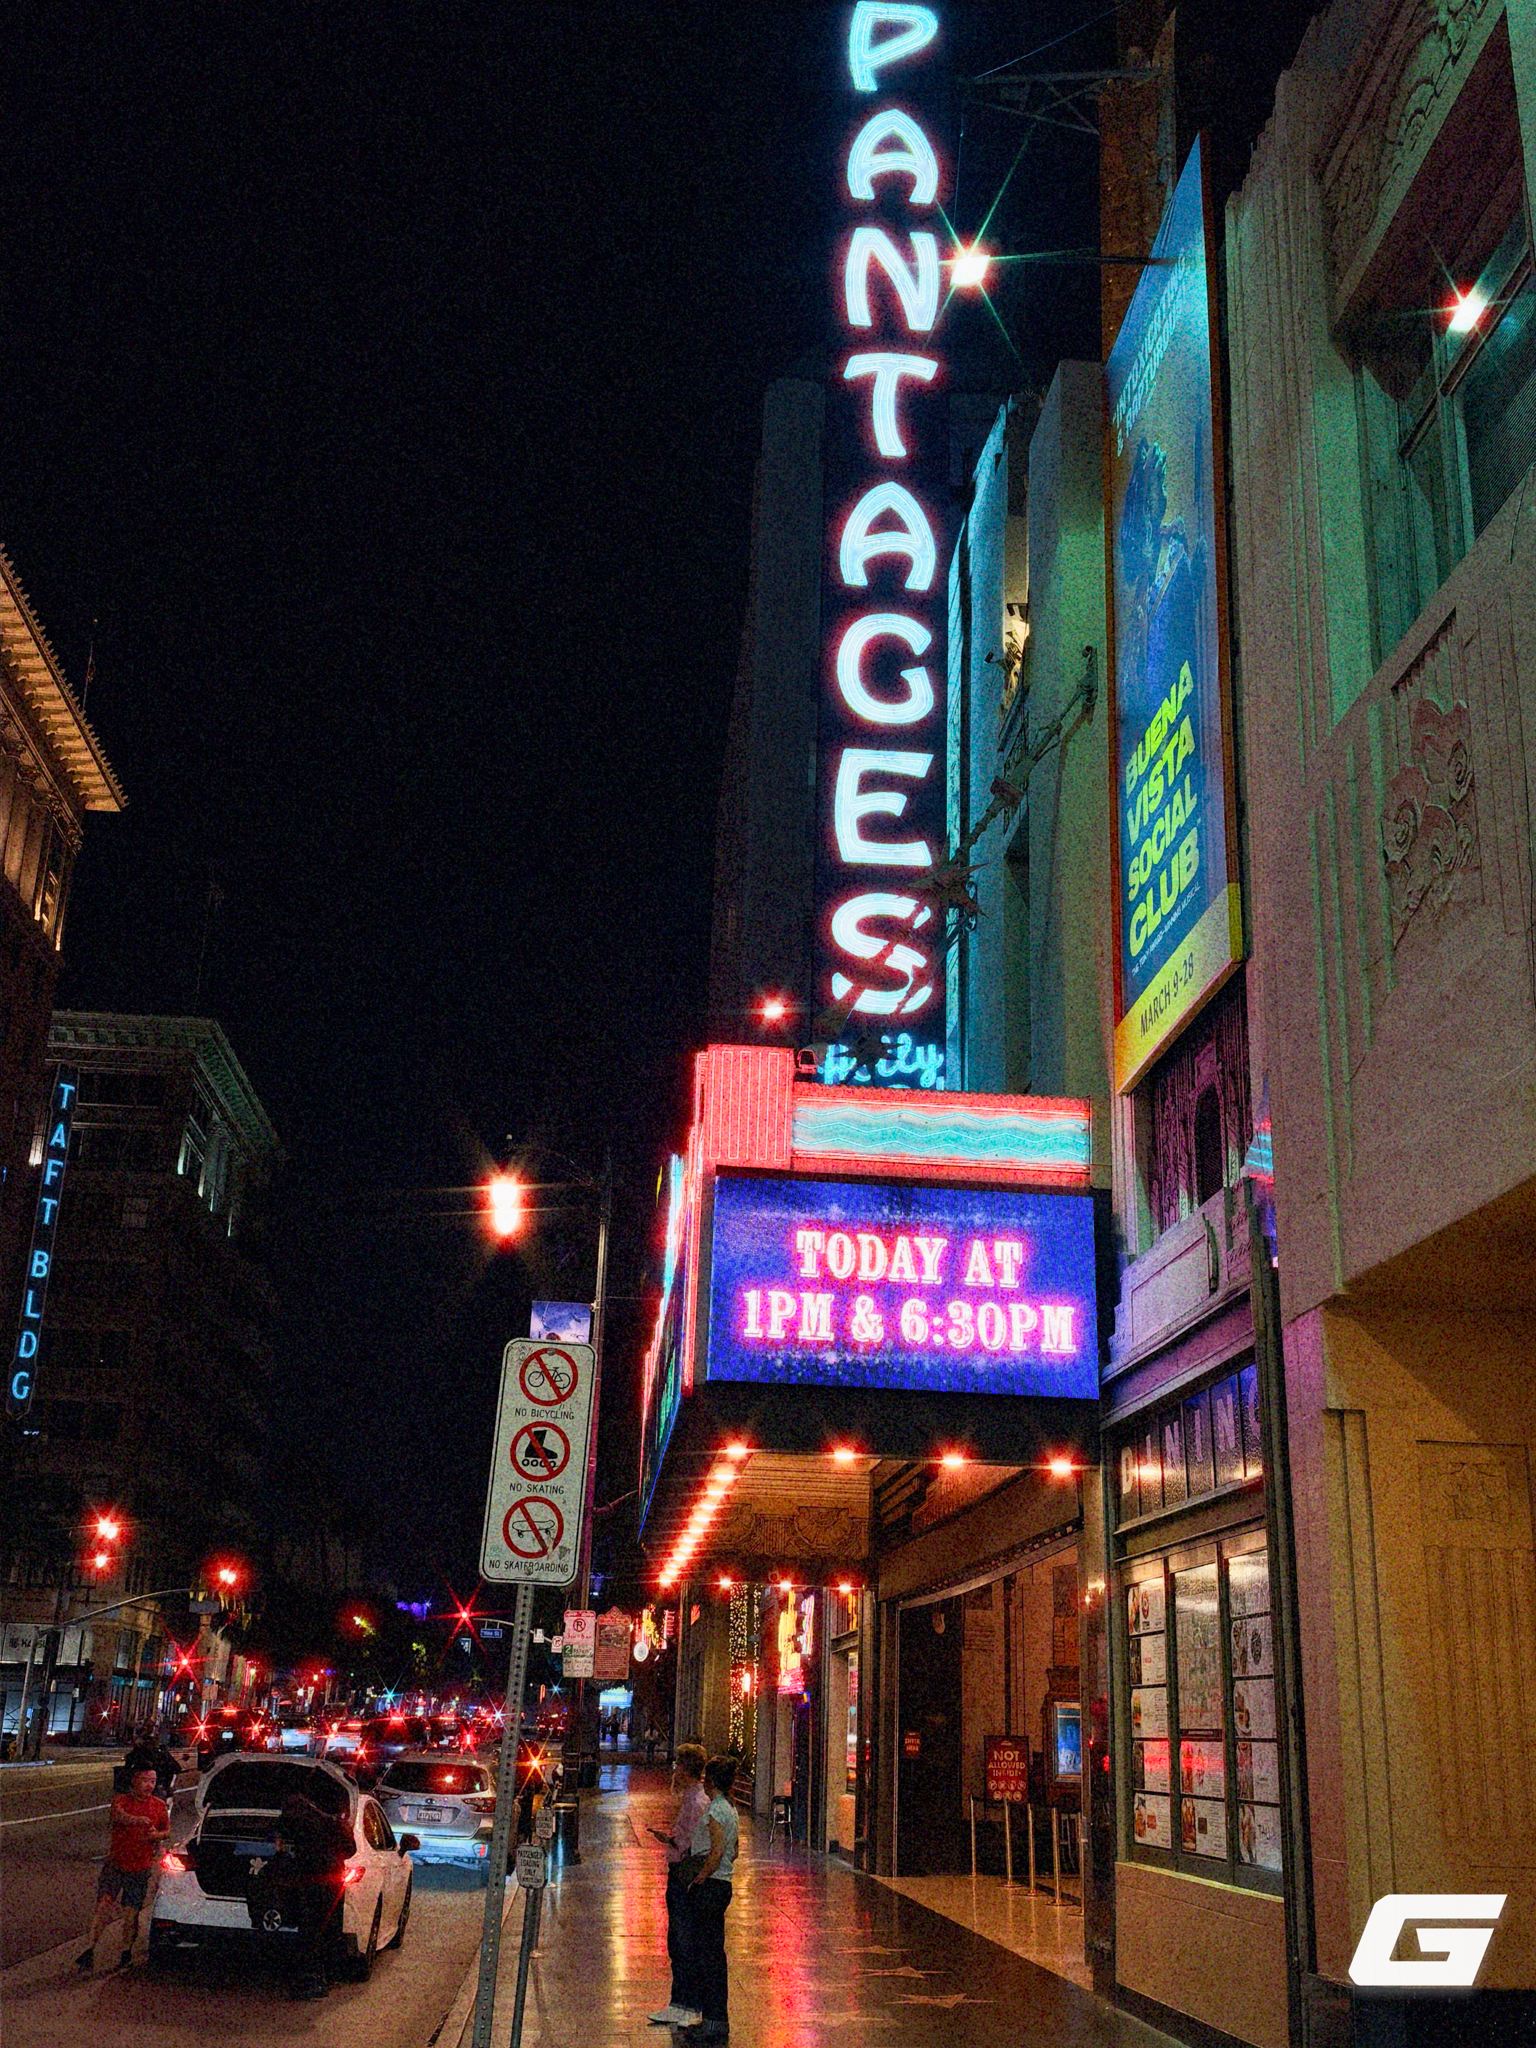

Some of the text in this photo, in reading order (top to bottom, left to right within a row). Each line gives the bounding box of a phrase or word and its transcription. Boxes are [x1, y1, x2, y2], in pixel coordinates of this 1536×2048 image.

[831, 1, 939, 1015] PANTAGES
[1126, 660, 1194, 798] BUENA
[1127, 715, 1196, 846] VISTA
[1129, 773, 1197, 901] SOCIAL
[1130, 827, 1199, 957] CLUB
[1140, 980, 1170, 1038] MARCH
[11, 1083, 75, 1400] TAFT BLDG
[796, 1230, 1023, 1288] TODAY AT
[743, 1289, 1077, 1354] 1PM & 6:30PM
[515, 1408, 575, 1420] NO BICYCLING
[510, 1483, 564, 1495] NO SKATING
[489, 1560, 500, 1569] NO
[994, 1750, 1020, 1761] NOT
